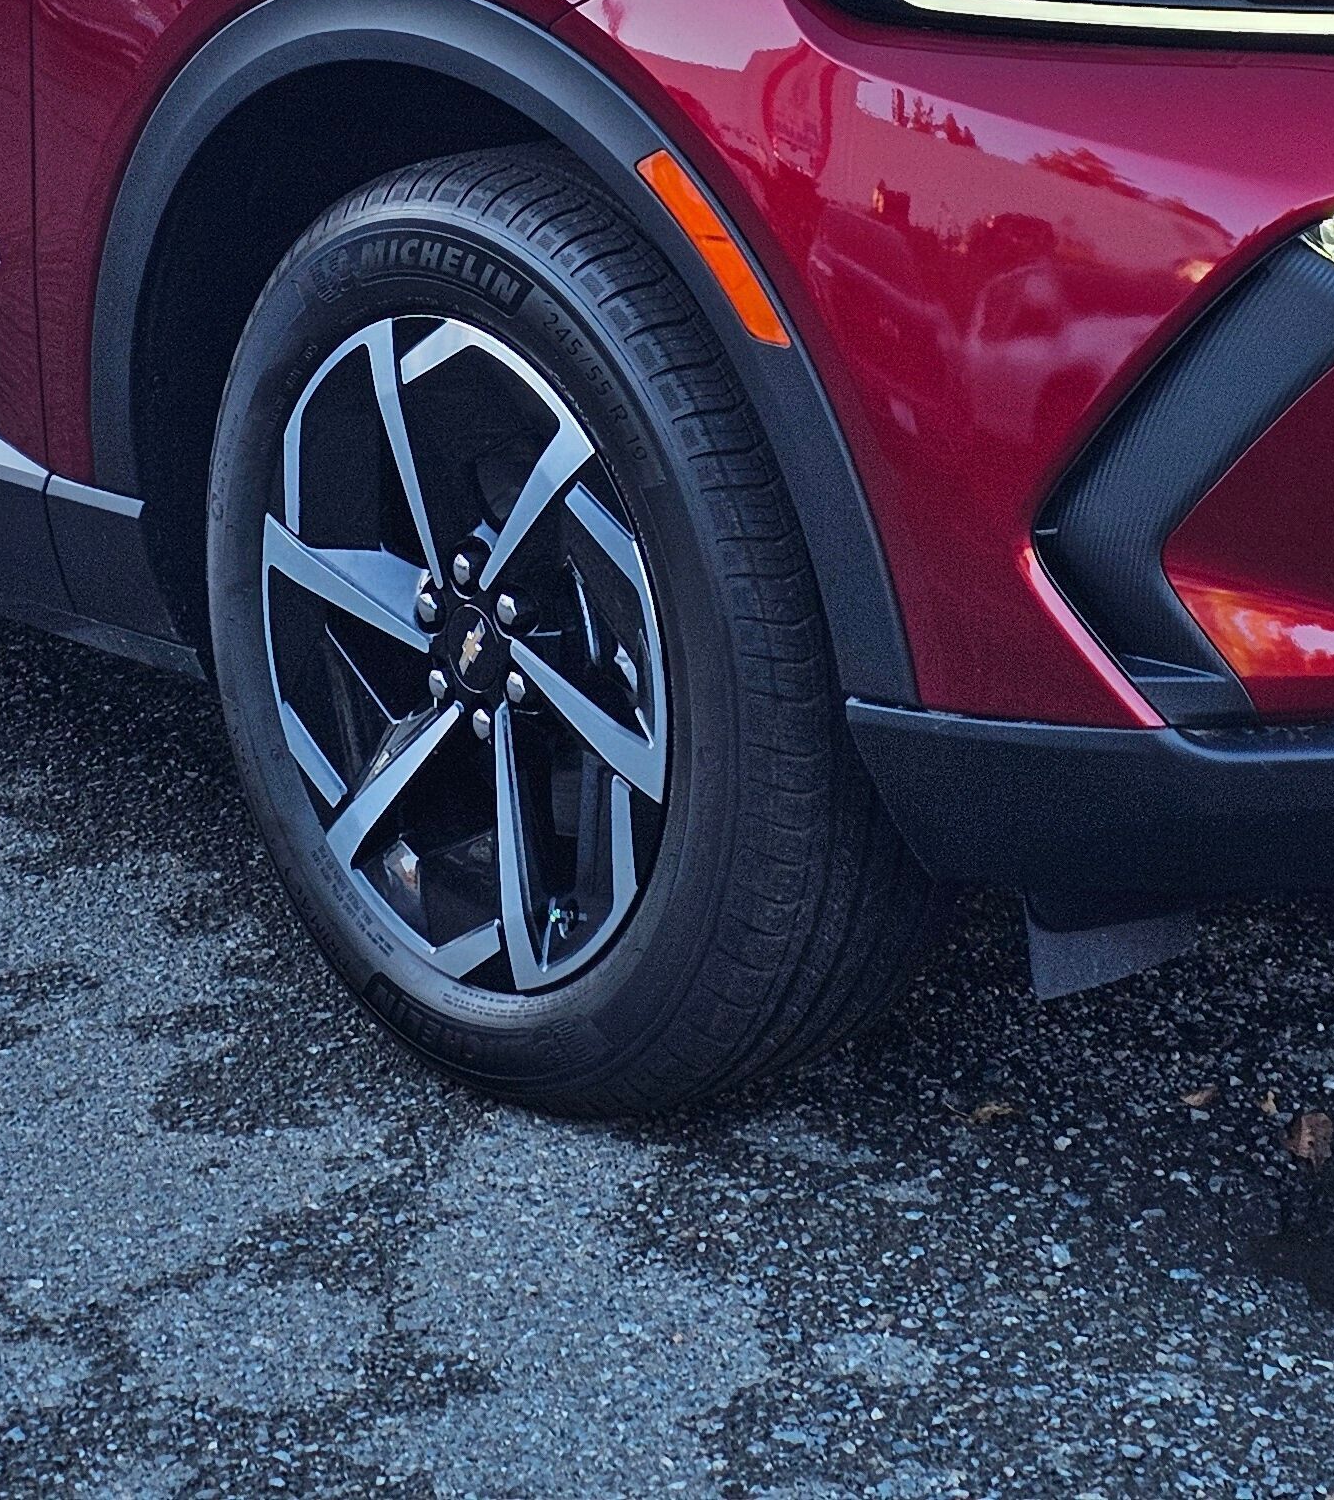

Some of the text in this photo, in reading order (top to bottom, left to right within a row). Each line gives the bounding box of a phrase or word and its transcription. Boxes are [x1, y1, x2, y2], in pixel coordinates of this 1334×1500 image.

[360, 238, 521, 304] MICHELIN
[543, 312, 614, 396] 245/55
[626, 435, 648, 461] 19
